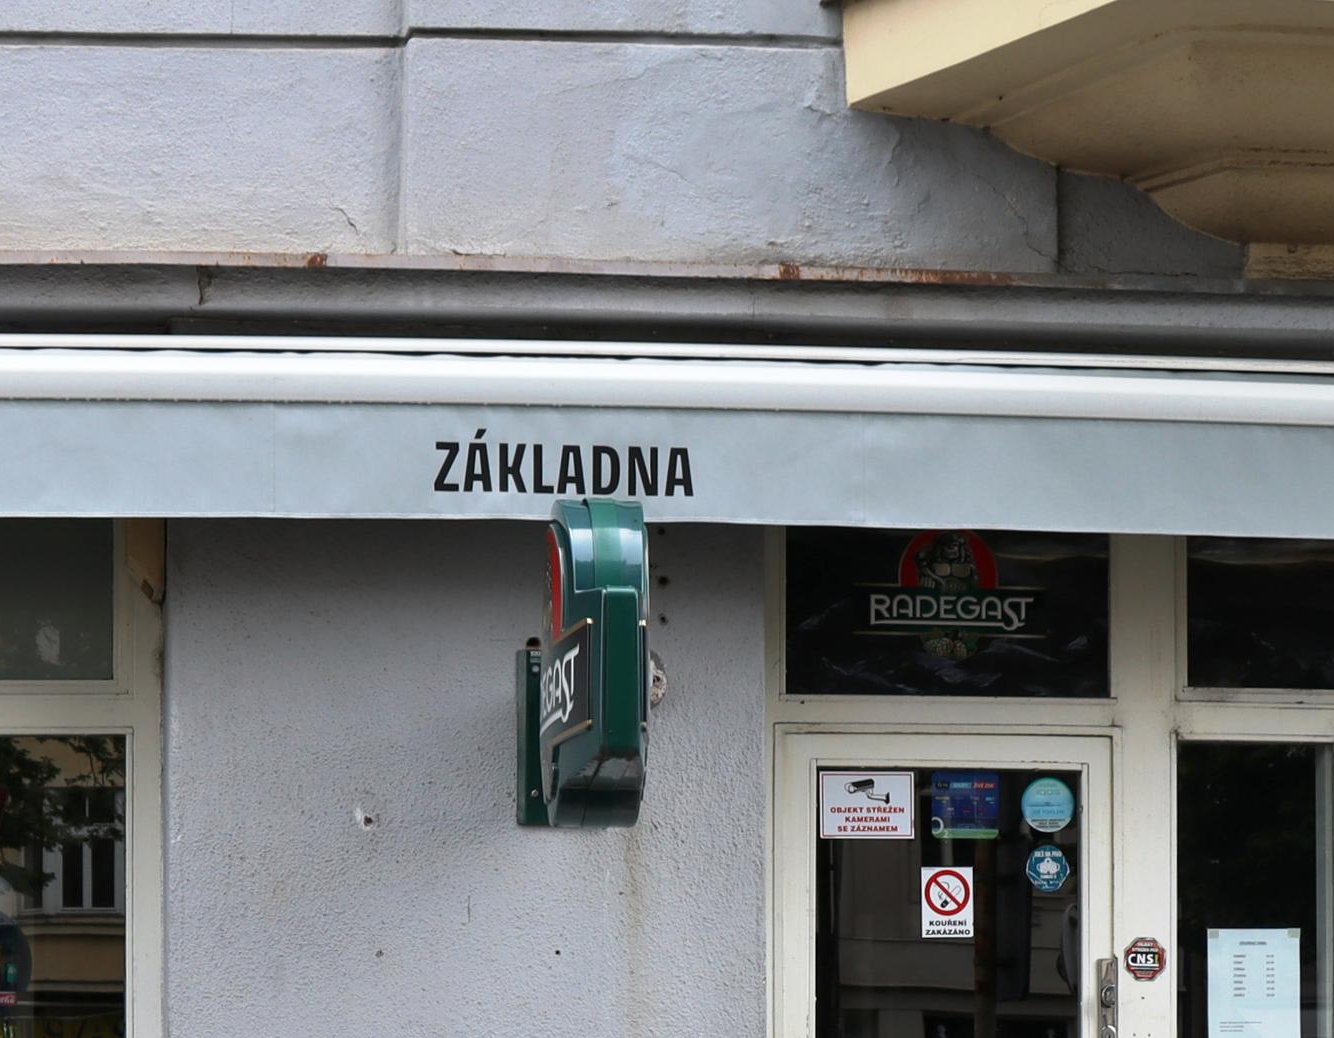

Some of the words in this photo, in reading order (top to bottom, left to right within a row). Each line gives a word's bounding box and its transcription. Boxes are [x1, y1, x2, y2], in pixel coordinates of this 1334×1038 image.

[433, 428, 694, 497] ZÁKLADNA
[869, 593, 1034, 631] RADEGAST
[539, 643, 580, 736] EGAST
[830, 806, 864, 814] OBJEKT
[866, 805, 905, 814] STŘEŽEN
[837, 825, 848, 833] SE
[850, 824, 898, 833] ZÁZNAMEM
[929, 918, 967, 927] KOUŘENÍ
[925, 928, 971, 936] ZAKÁZÁNO
